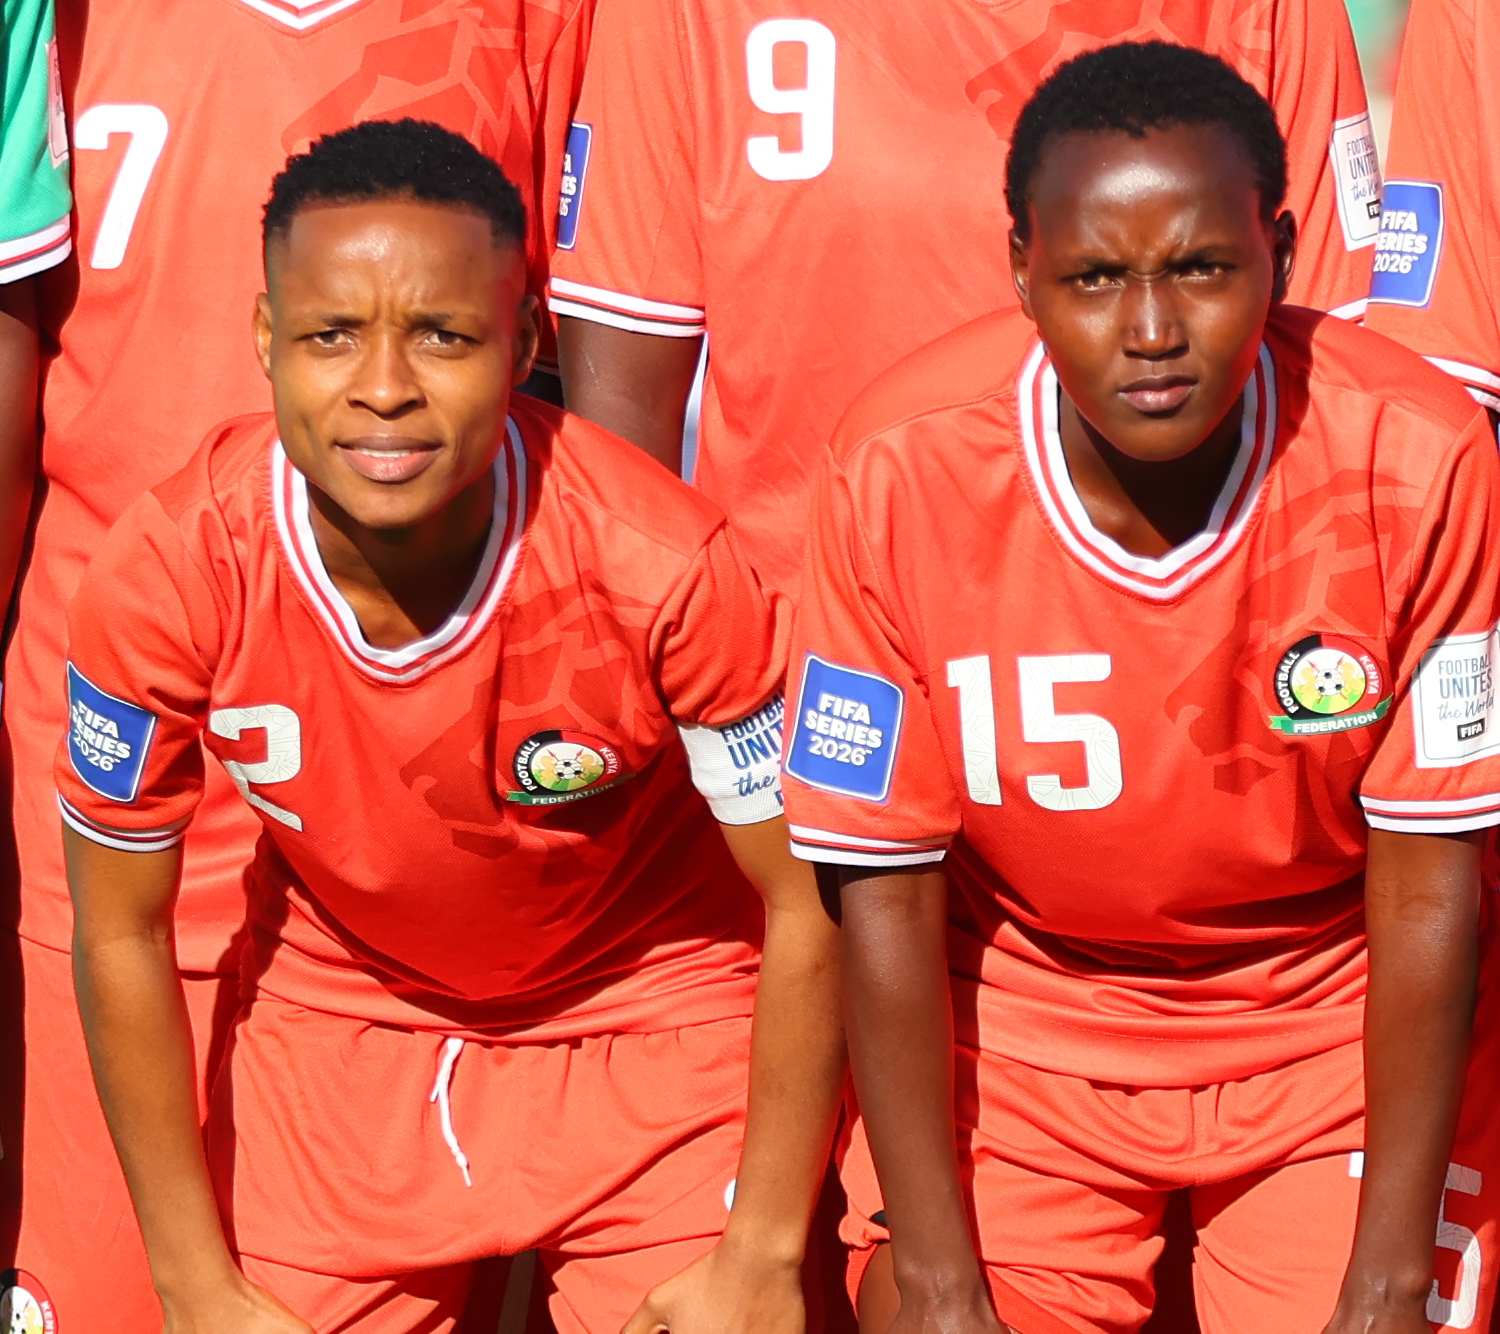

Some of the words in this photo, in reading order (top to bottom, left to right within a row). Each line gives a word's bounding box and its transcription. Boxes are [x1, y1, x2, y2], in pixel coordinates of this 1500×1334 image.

[745, 17, 836, 181] 9
[73, 103, 170, 270] 7
[1380, 211, 1419, 232] FIFA
[1373, 254, 1413, 274] 2026
[1359, 654, 1380, 696] KENYA
[1438, 652, 1492, 676] FOOTBALL
[1275, 649, 1301, 715] FOOTBALL
[1438, 668, 1493, 700] UNITES
[77, 699, 120, 739] FIFA
[818, 693, 872, 725] FIFA
[1293, 711, 1379, 734] FEDERATION
[1436, 700, 1463, 721] the
[71, 704, 131, 759] SERIES
[804, 710, 883, 749] SERIES
[945, 653, 1125, 813] 15
[1460, 722, 1484, 739] FIFA
[73, 729, 115, 772] 2026
[208, 703, 303, 833] 2
[516, 740, 541, 792] FOOTBALL
[599, 747, 619, 775] KENYA
[808, 735, 867, 766] 2026
[731, 771, 776, 797] the
